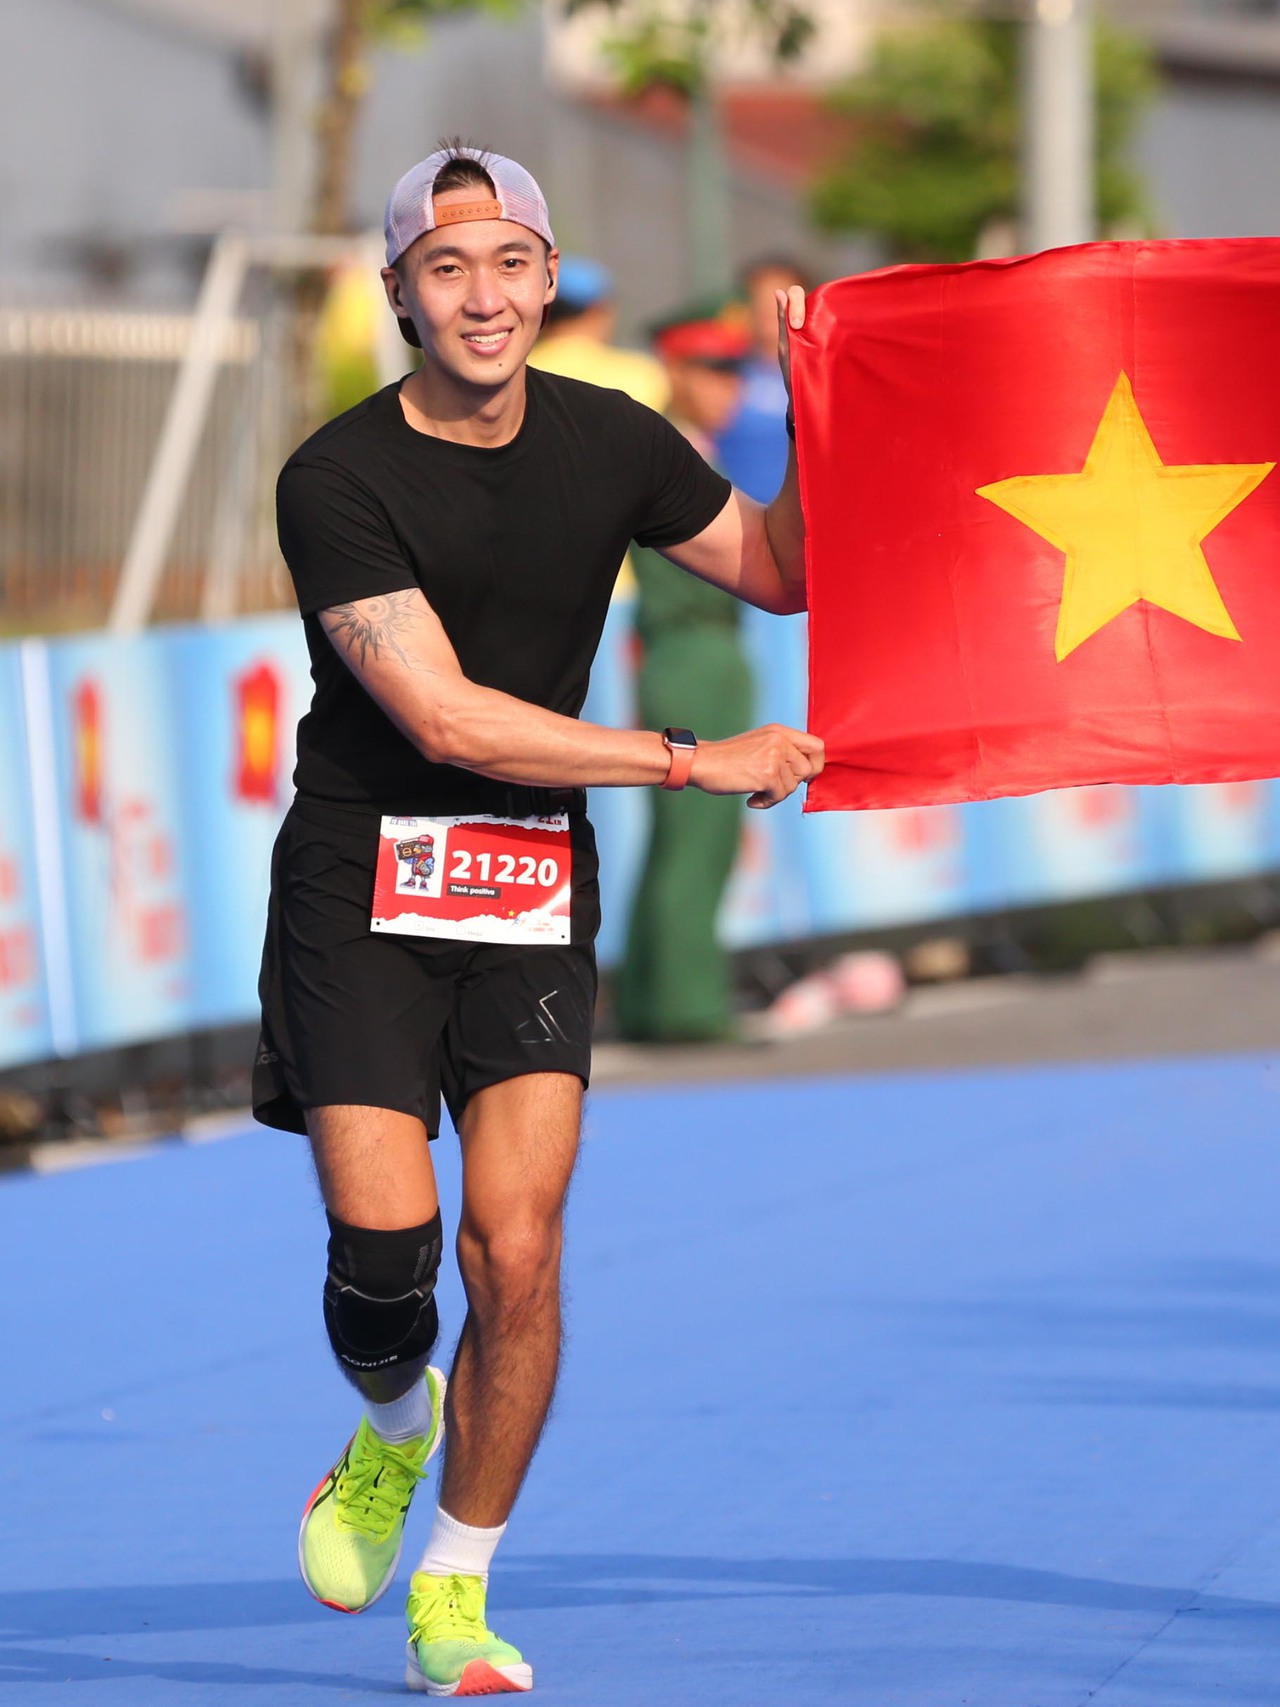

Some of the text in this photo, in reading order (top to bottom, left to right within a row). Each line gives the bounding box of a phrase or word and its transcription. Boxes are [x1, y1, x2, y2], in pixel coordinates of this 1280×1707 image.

[449, 850, 559, 888] 21220
[450, 885, 495, 896] Think positive
